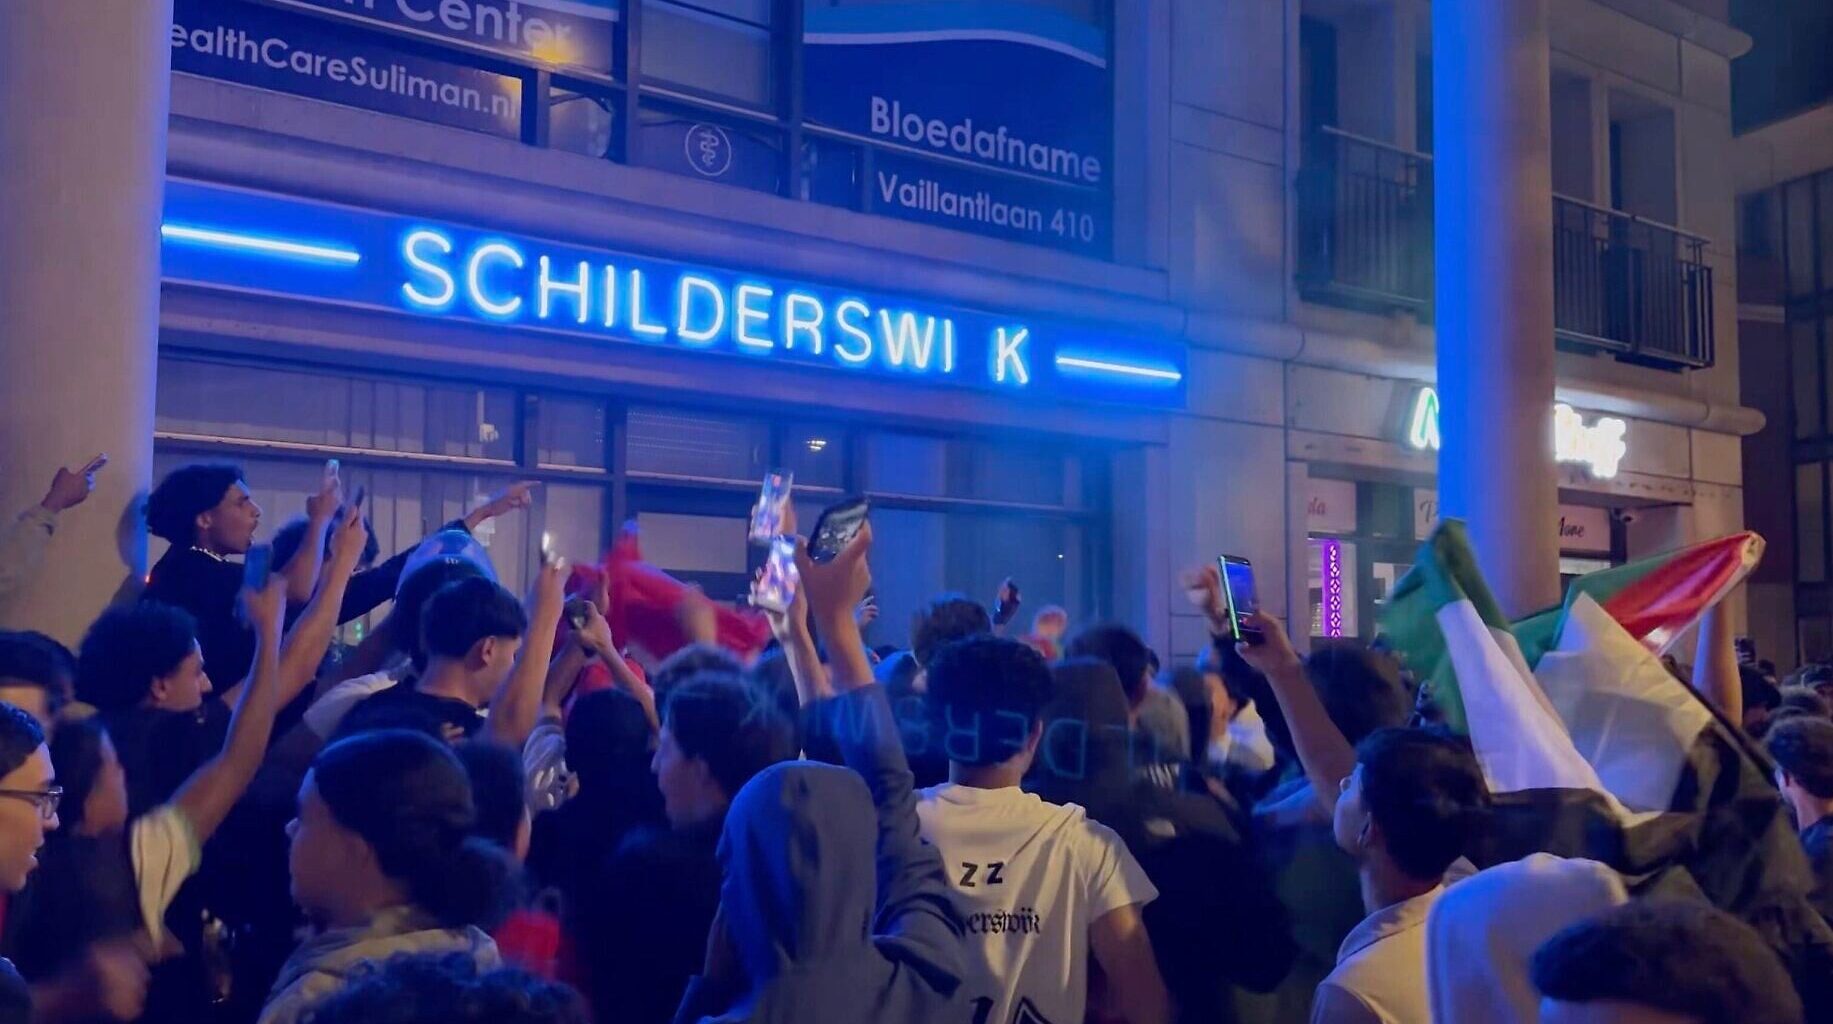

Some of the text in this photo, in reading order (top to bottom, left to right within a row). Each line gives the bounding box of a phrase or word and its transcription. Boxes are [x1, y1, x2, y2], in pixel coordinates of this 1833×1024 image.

[871, 96, 1100, 183] Bloedafname
[878, 171, 1095, 242] Vaillantlaan 410
